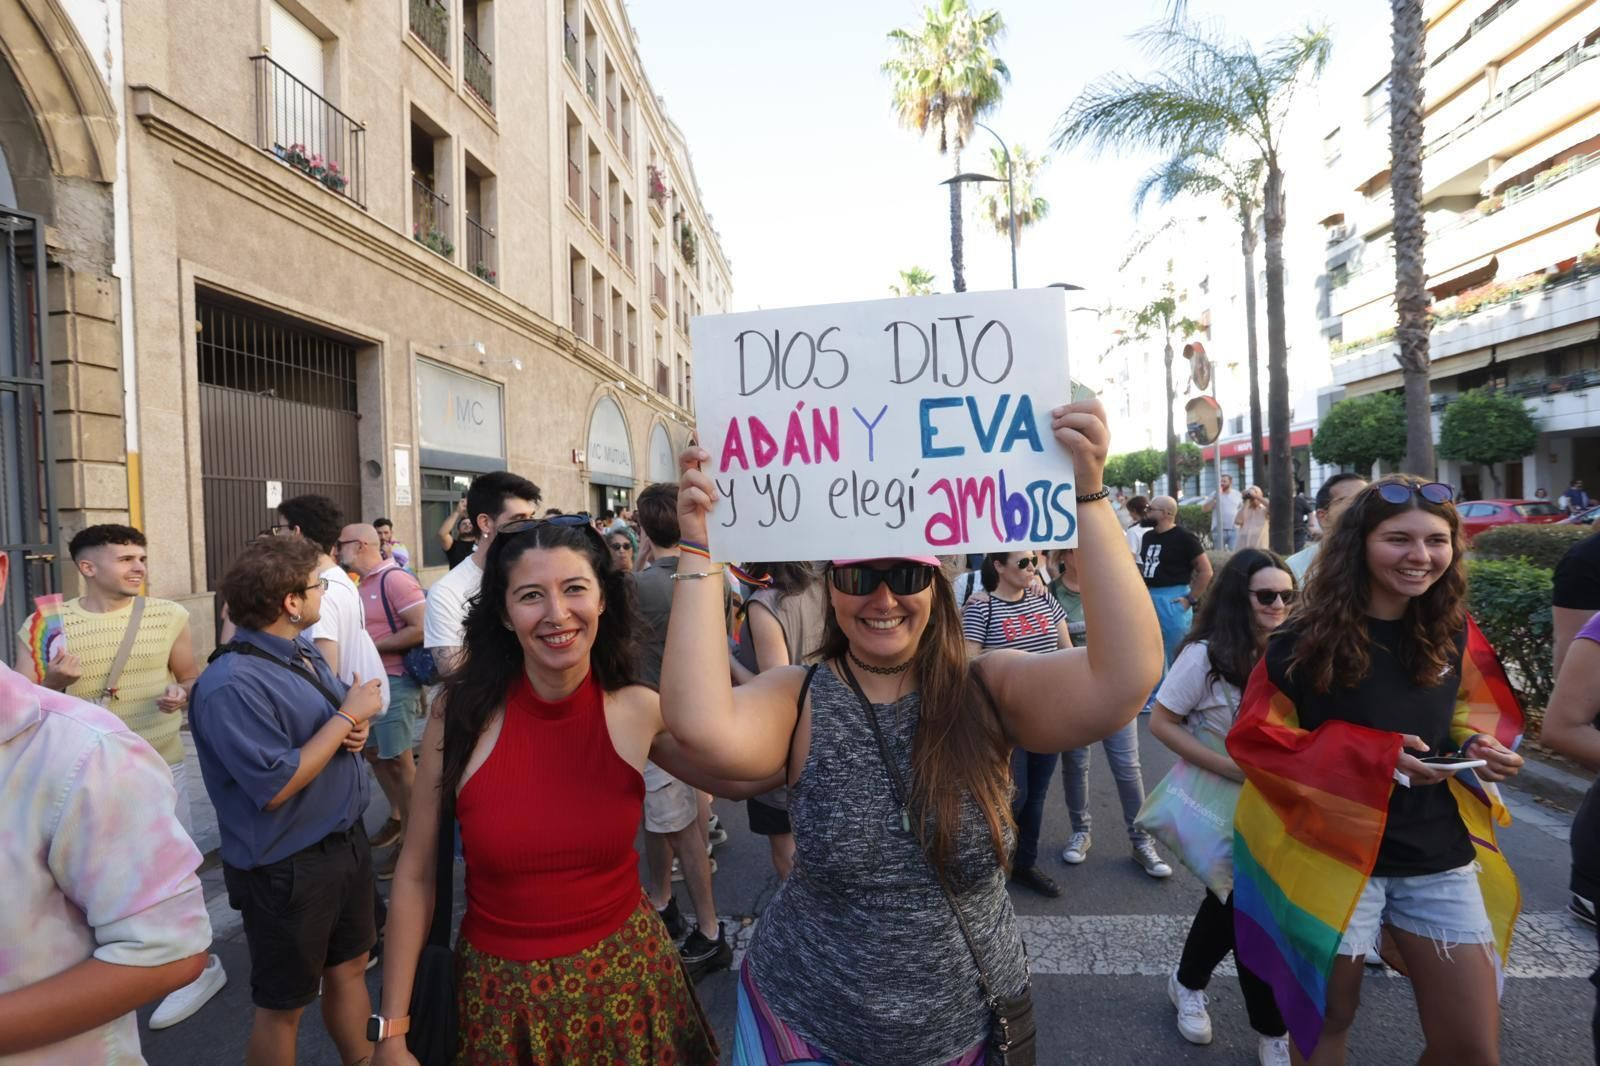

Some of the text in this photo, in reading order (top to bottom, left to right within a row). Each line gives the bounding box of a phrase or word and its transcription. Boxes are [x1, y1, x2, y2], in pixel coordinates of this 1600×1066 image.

[734, 315, 1014, 397] DIOS DIJO
[456, 395, 485, 426] MC
[719, 393, 1045, 473] ADÁN Y EVA
[715, 474, 738, 528] y
[828, 468, 920, 529] elegí
[924, 468, 1077, 547] ambos
[1002, 612, 1050, 642] GAP
